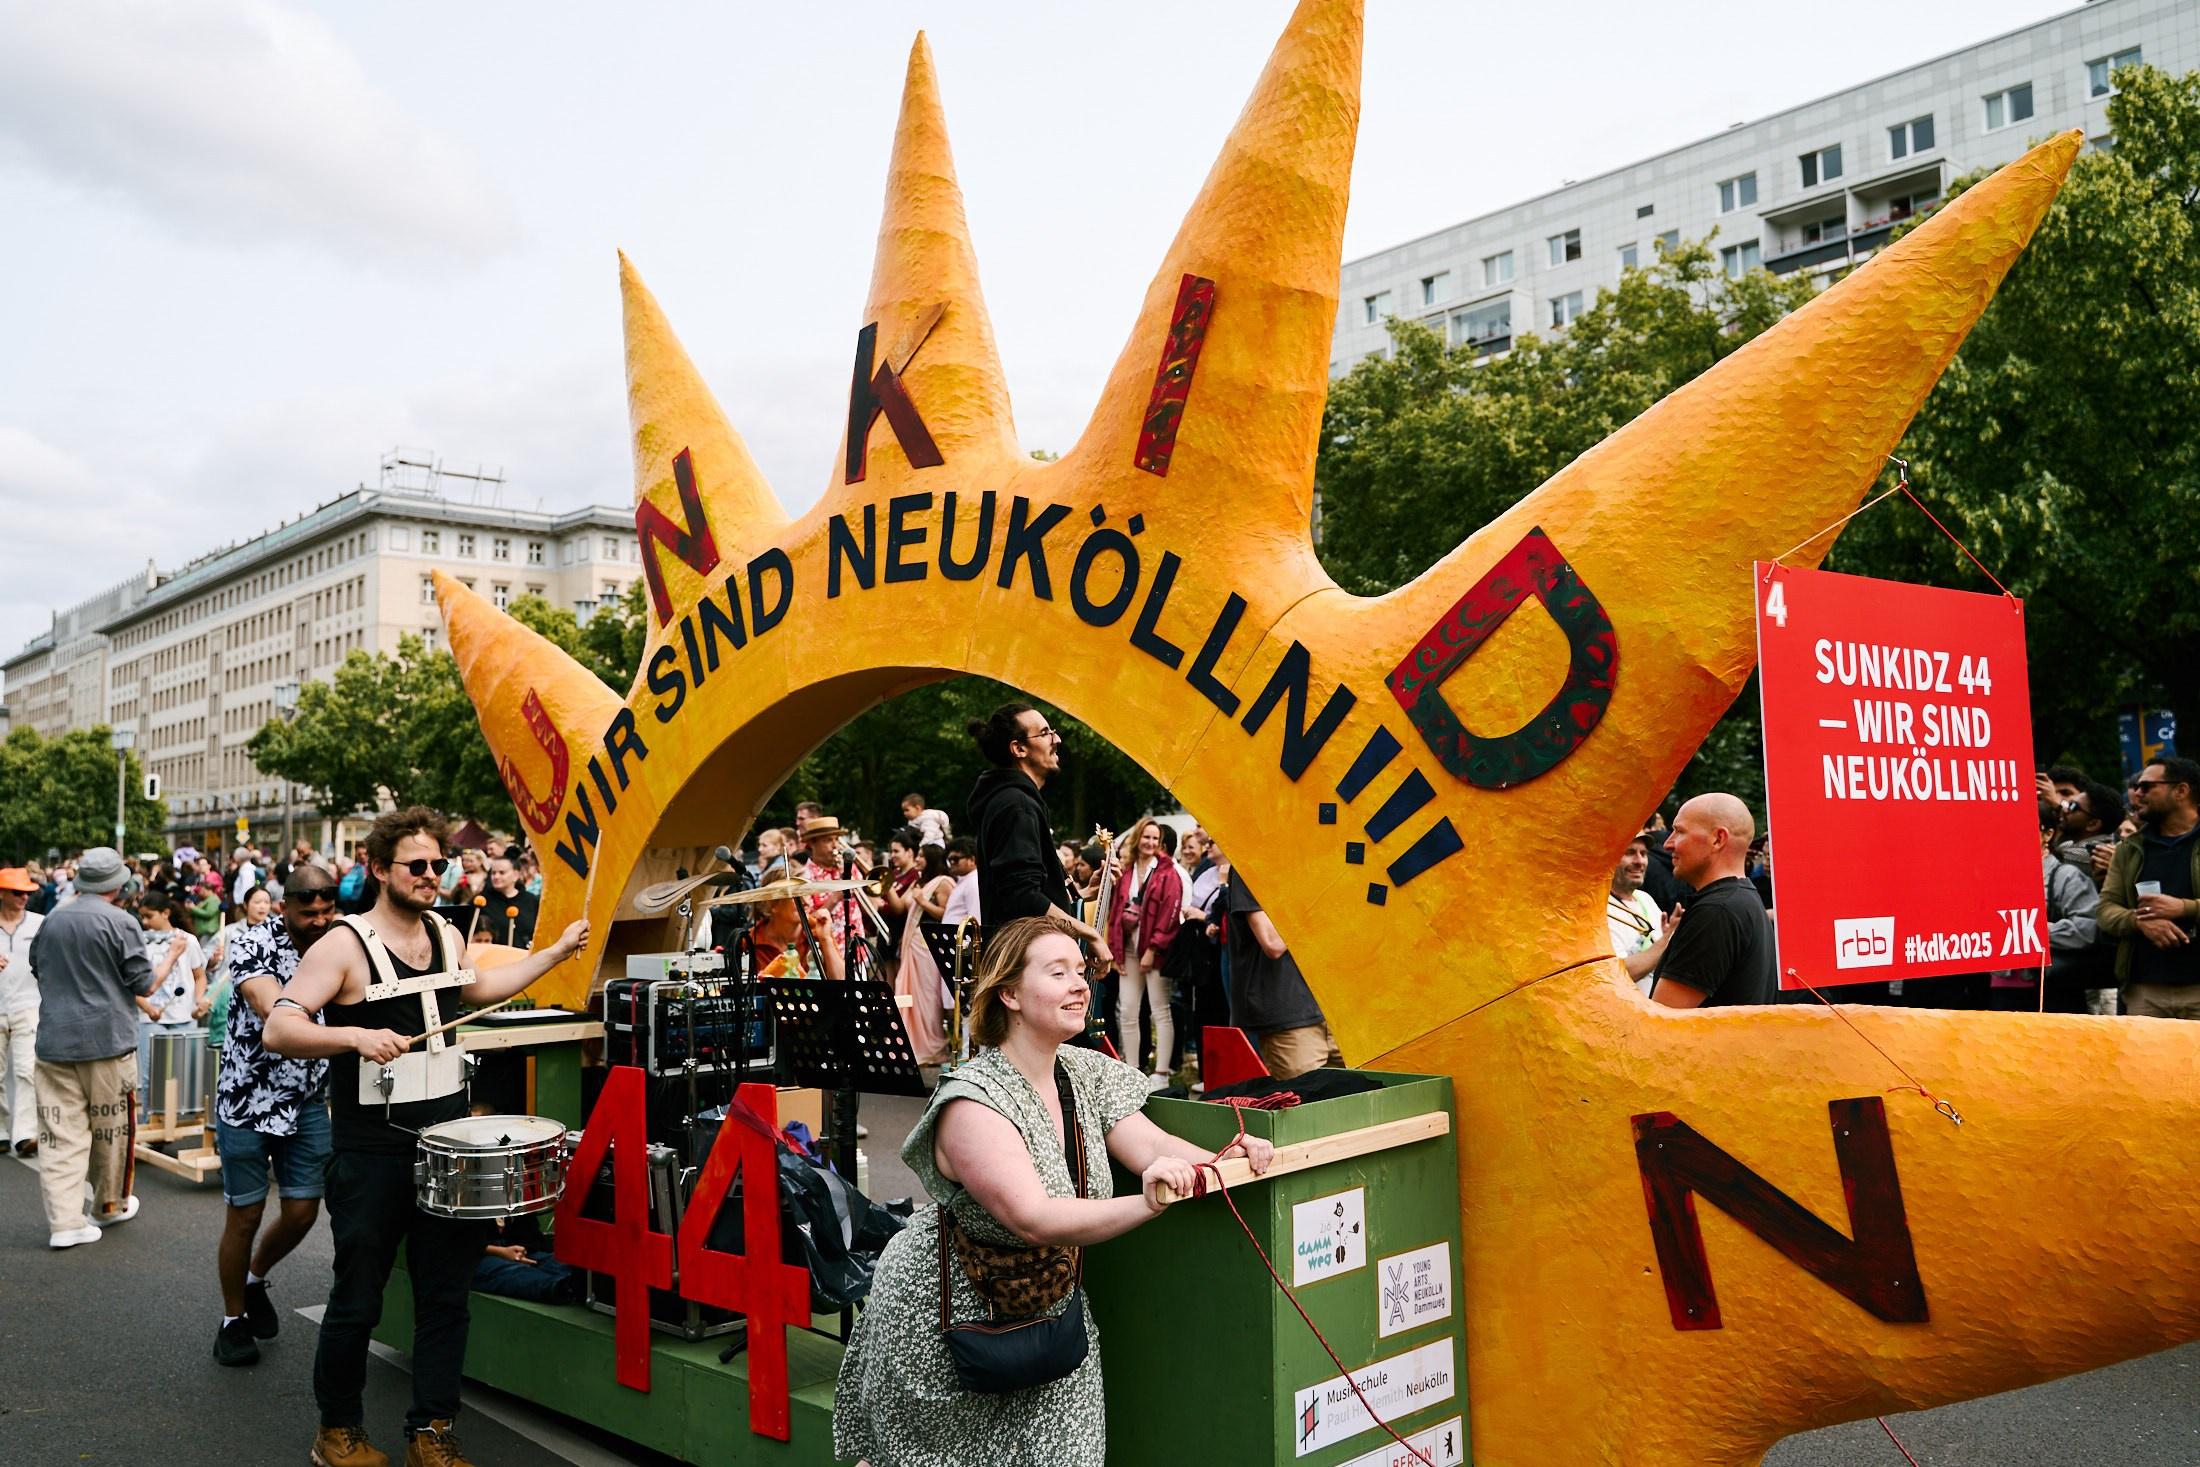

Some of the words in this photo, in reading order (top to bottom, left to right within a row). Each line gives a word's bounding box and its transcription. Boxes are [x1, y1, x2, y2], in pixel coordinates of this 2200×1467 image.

[1765, 581, 1787, 627] 4
[1814, 638, 1952, 693] SUNKIDZ
[1958, 656, 1991, 695] 44
[555, 707, 649, 879] WIR
[647, 547, 794, 723] SIND
[1853, 699, 1915, 745] WIR
[1922, 704, 1991, 748] SIND
[1822, 746, 2019, 802] NEUKÖLLN!!!
[1842, 928, 1887, 957] rbb
[1905, 931, 1992, 964] #kdk2025
[1413, 1259, 1431, 1274] YOUNG
[1415, 1298, 1446, 1314] Dammweg
[1327, 1404, 1350, 1428] Paul
[1406, 1371, 1448, 1397] Neukölln
